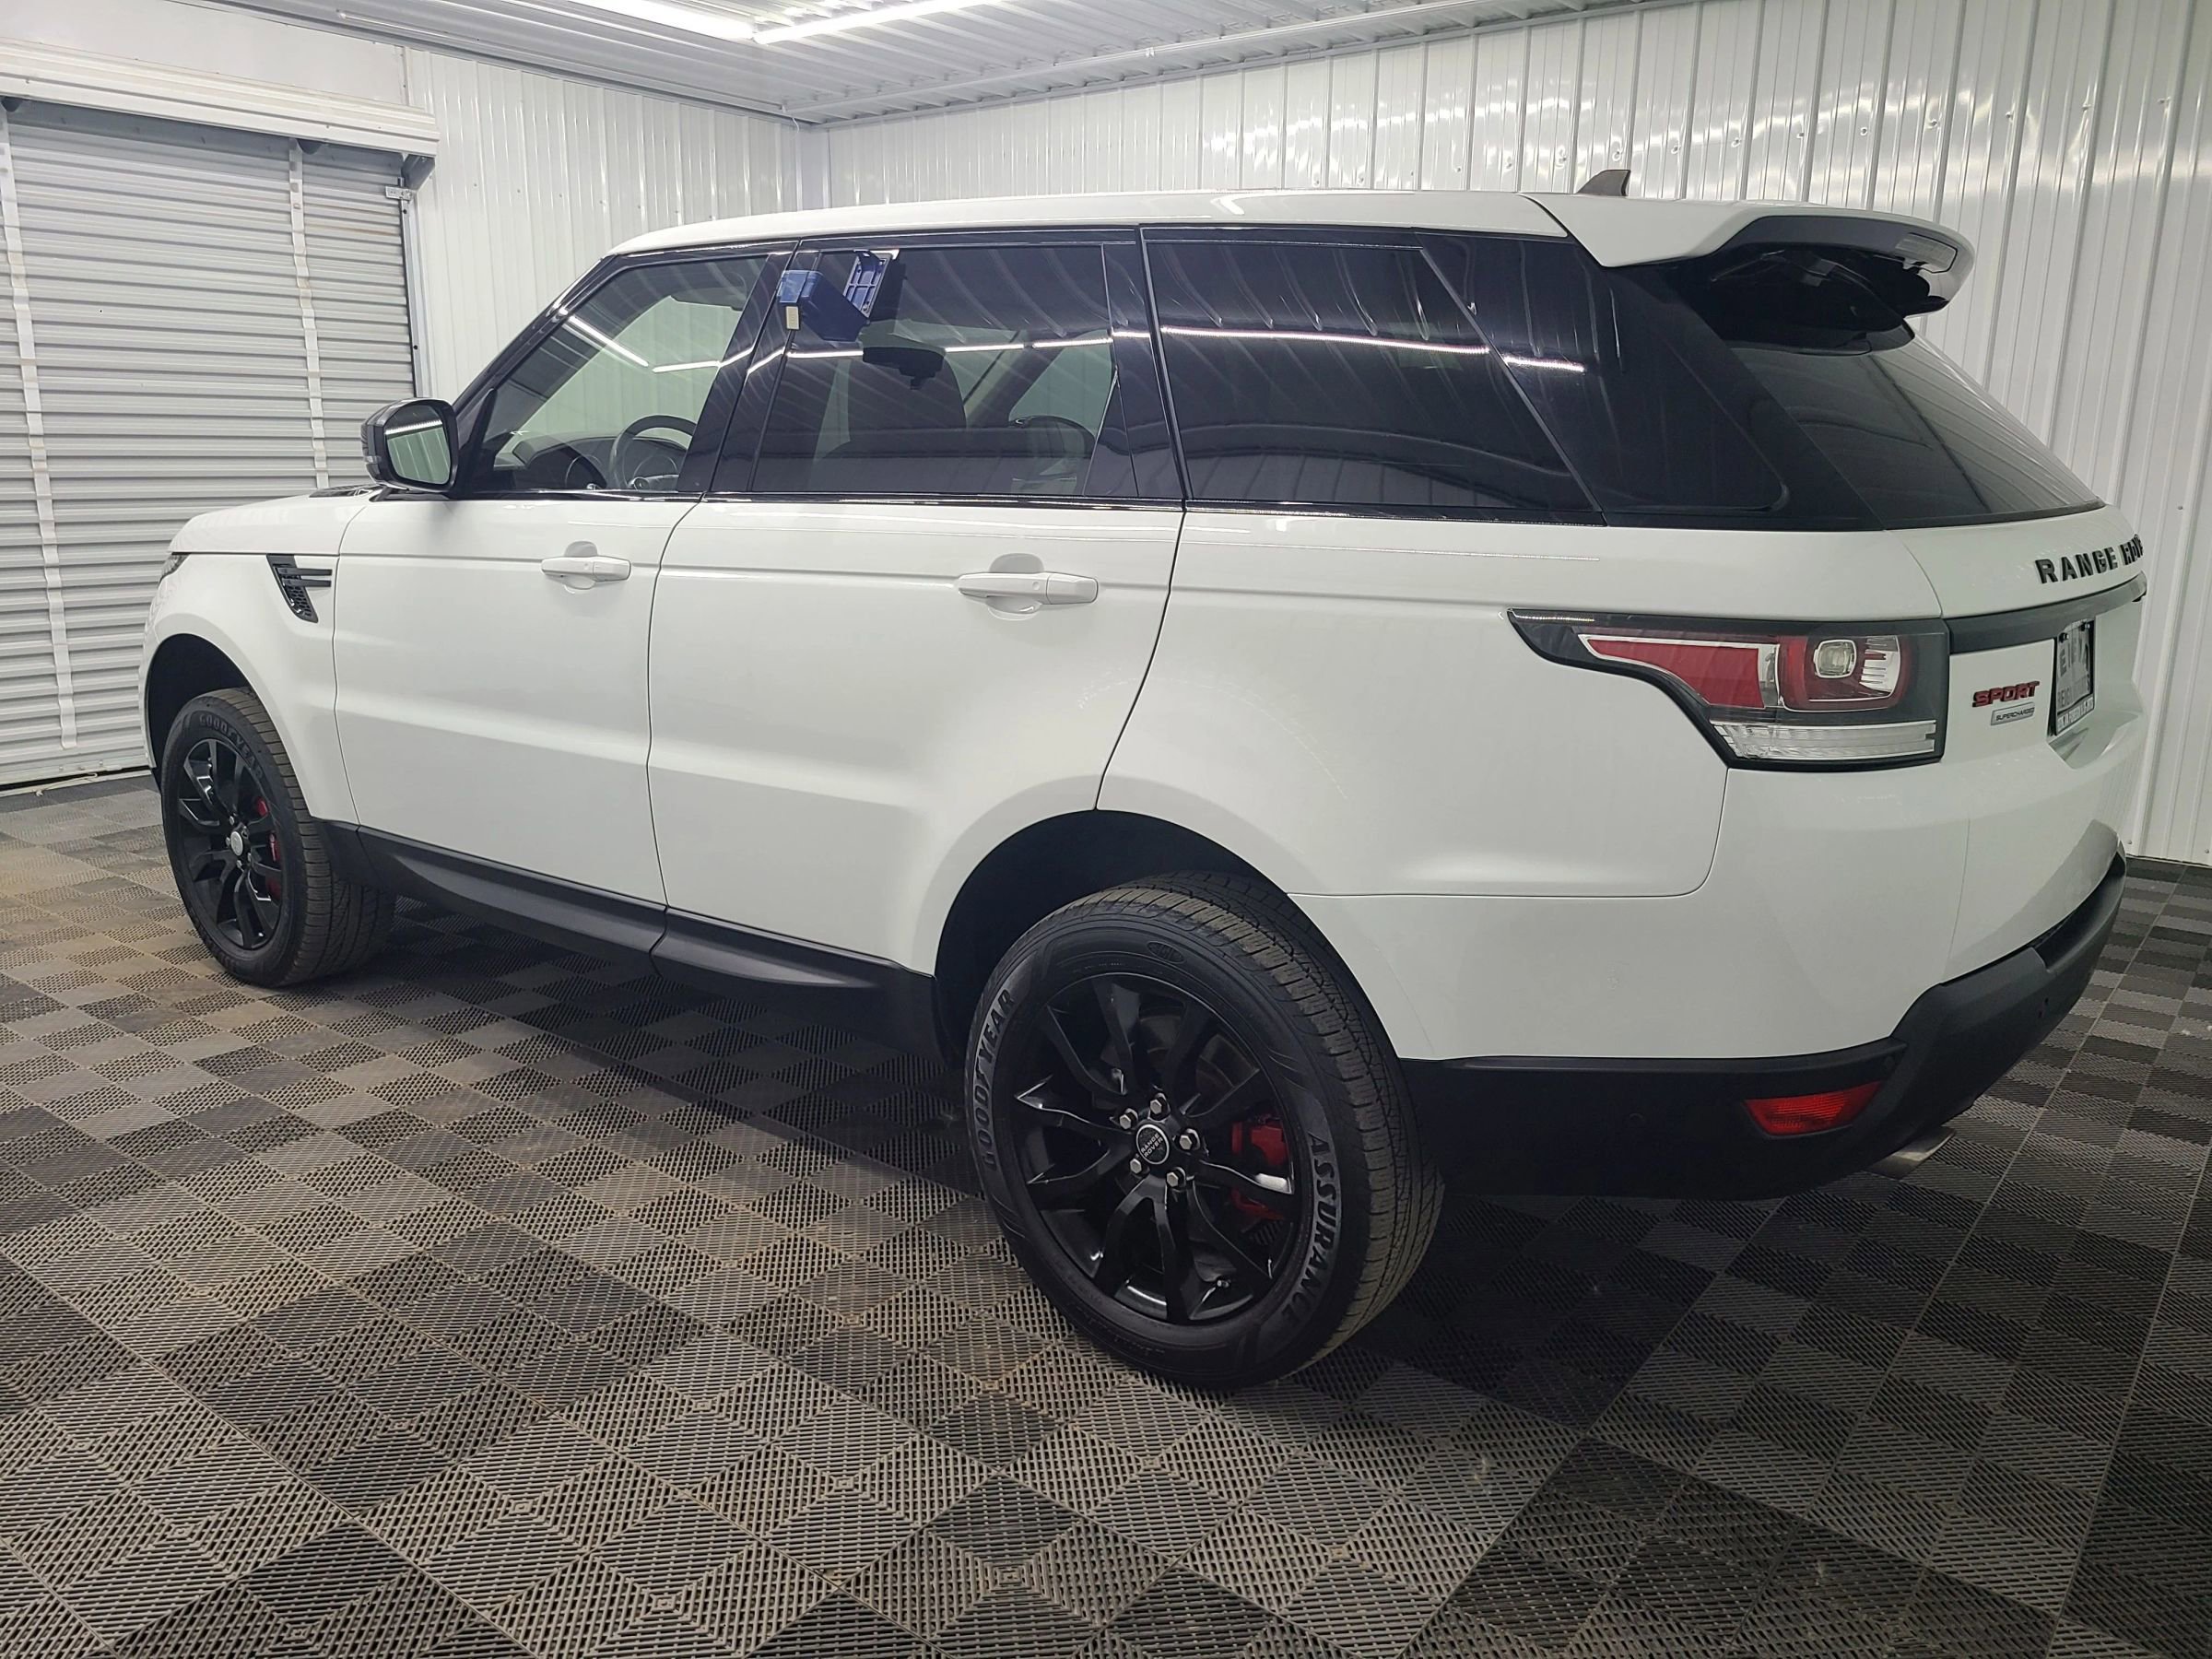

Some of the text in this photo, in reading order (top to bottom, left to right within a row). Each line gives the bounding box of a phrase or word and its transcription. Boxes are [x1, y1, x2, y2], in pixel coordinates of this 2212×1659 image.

[2035, 547, 2118, 583] RANGE
[1972, 681, 2040, 708] SPORT
[975, 989, 1014, 1171] GOODYEAR
[1141, 1133, 1159, 1153] RANGE
[1144, 1136, 1163, 1158] ROVER
